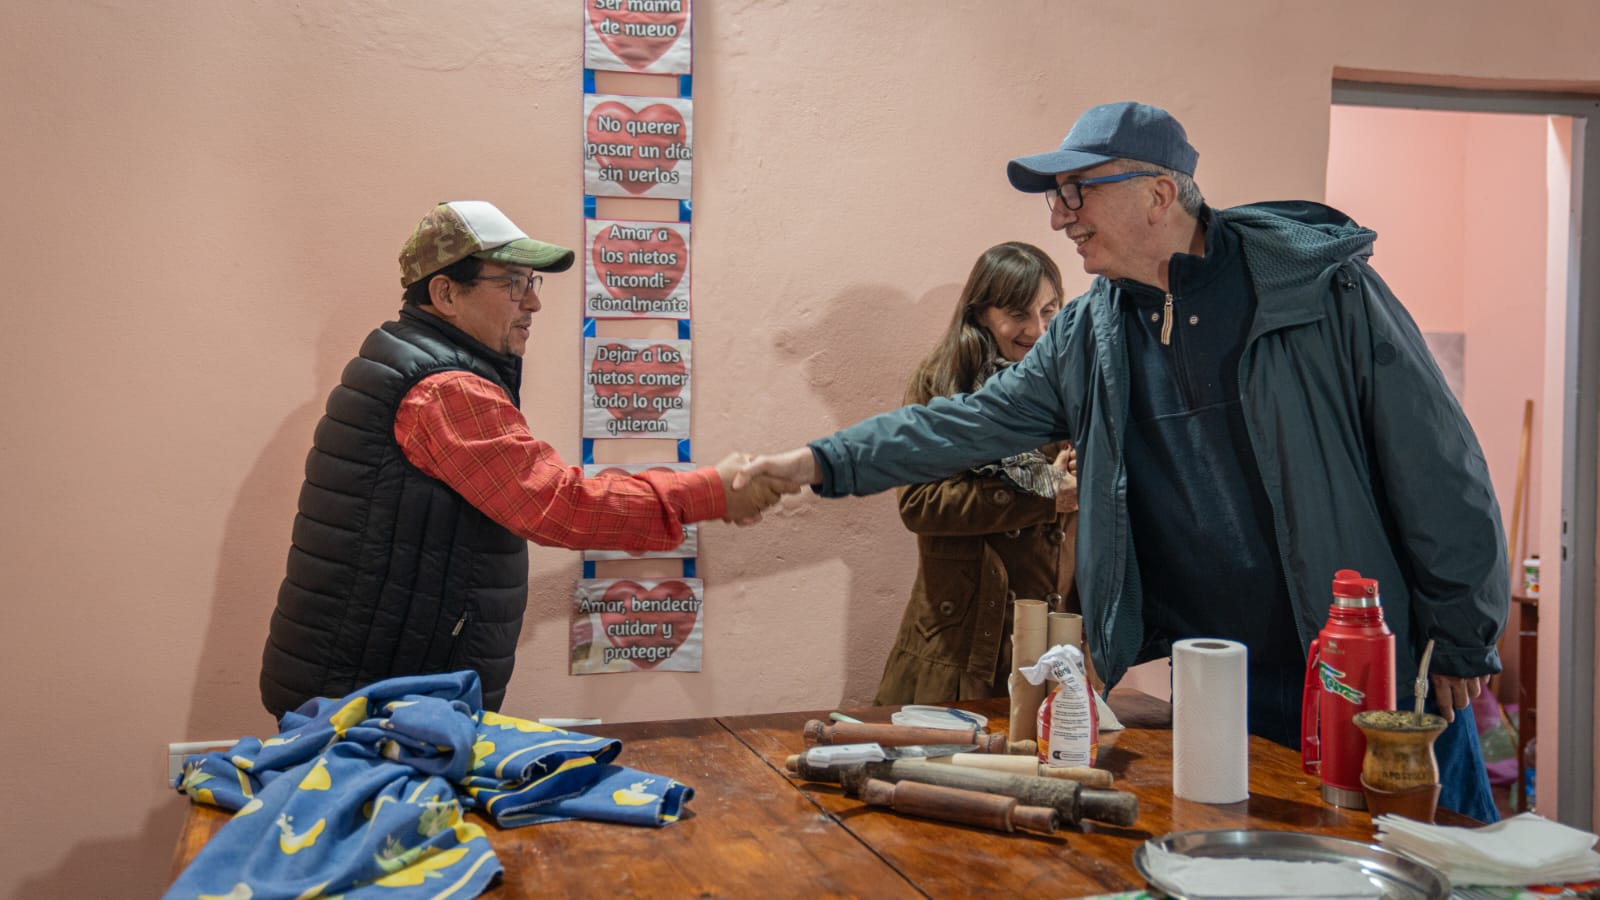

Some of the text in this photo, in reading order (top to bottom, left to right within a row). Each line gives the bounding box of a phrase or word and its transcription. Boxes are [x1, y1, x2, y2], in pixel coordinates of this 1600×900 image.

[600, 18, 678, 37] de nuevo
[598, 116, 680, 136] No querer
[586, 143, 692, 160] pasar un día
[599, 165, 679, 183] sin verlos
[609, 224, 668, 241] Amar a
[601, 248, 677, 265] los nietos
[606, 272, 672, 288] incondi-
[589, 296, 688, 312] cionalmente
[597, 347, 681, 365] Dejar a los
[587, 371, 688, 386] nietos comer
[593, 393, 682, 413] todo lo que
[607, 418, 667, 434] quieran
[580, 595, 701, 614] Amar, bendecir
[607, 621, 672, 638] cuidar y
[604, 646, 673, 664] proteger
